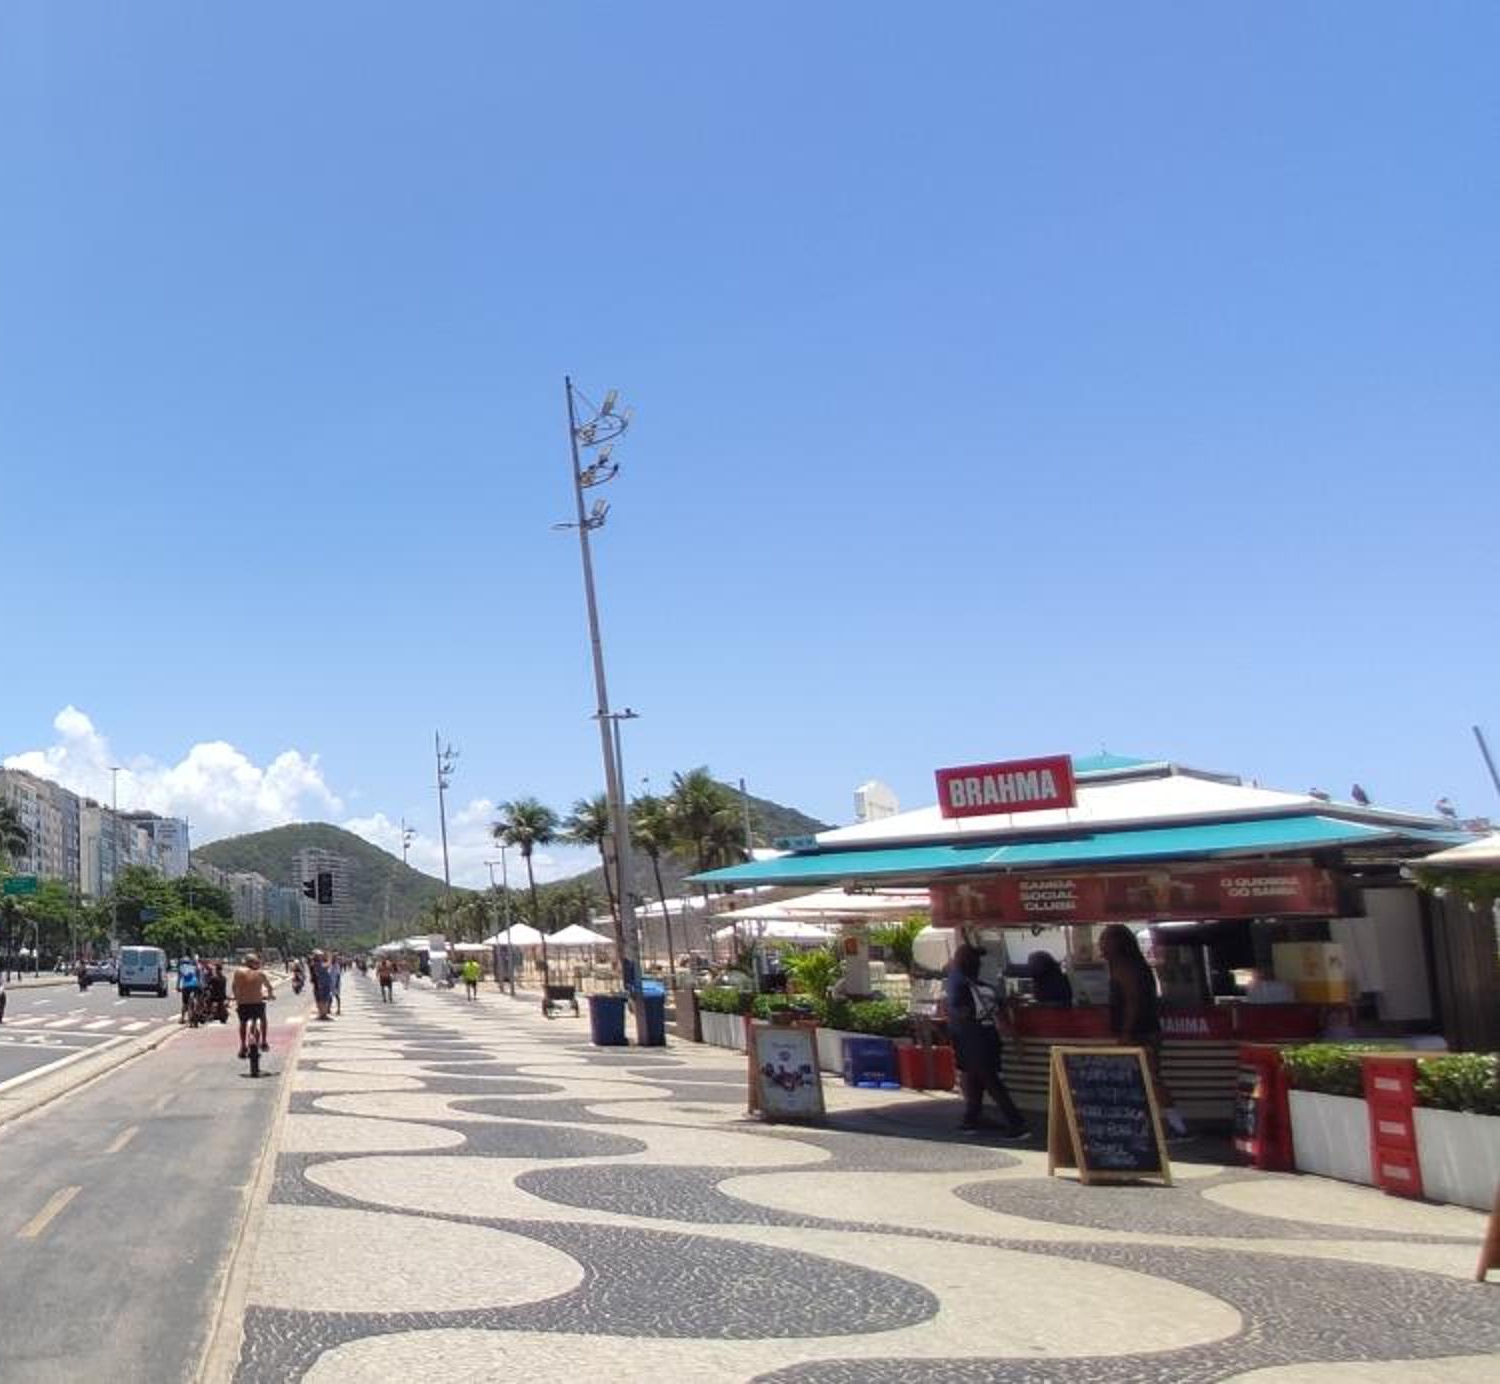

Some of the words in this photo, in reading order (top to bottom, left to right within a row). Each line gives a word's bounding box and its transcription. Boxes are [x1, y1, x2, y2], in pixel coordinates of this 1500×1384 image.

[949, 769, 1057, 808] BRAHMA
[1019, 880, 1077, 890] SAMBA
[1019, 890, 1079, 901] SOCIAL
